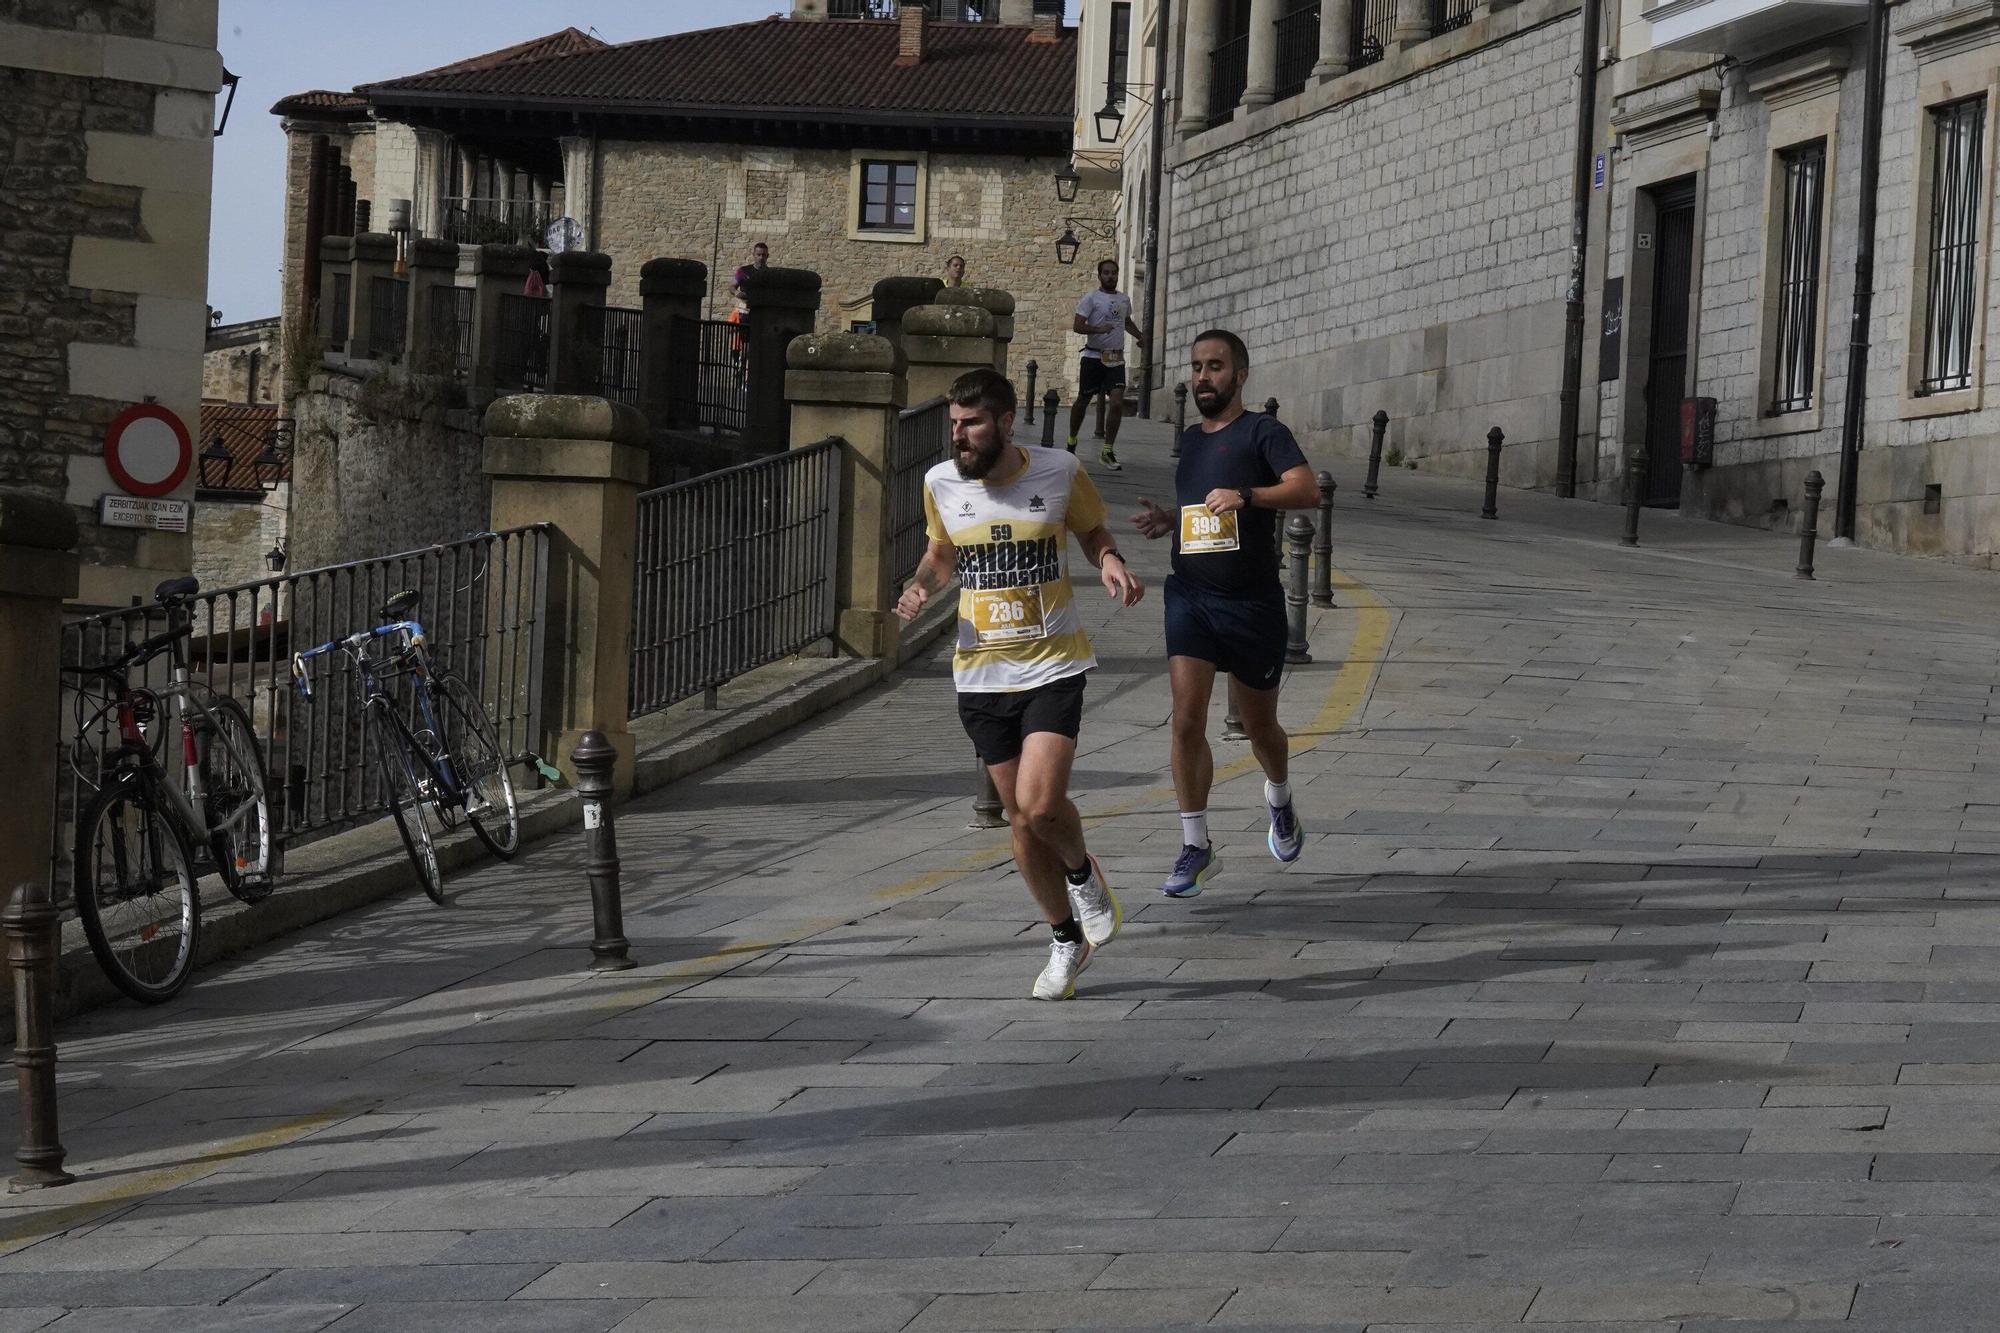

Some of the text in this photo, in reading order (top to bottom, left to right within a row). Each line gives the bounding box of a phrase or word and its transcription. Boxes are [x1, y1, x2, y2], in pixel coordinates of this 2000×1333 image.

[1640, 235, 1649, 247] 5
[109, 499, 184, 513] ZERBITZUAK IZAN EZIK
[113, 512, 142, 522] EXCEPTO
[1192, 515, 1220, 535] 398
[991, 524, 1012, 541] 59
[980, 562, 1060, 590] SEBASTIAN
[989, 600, 1025, 624] 236
